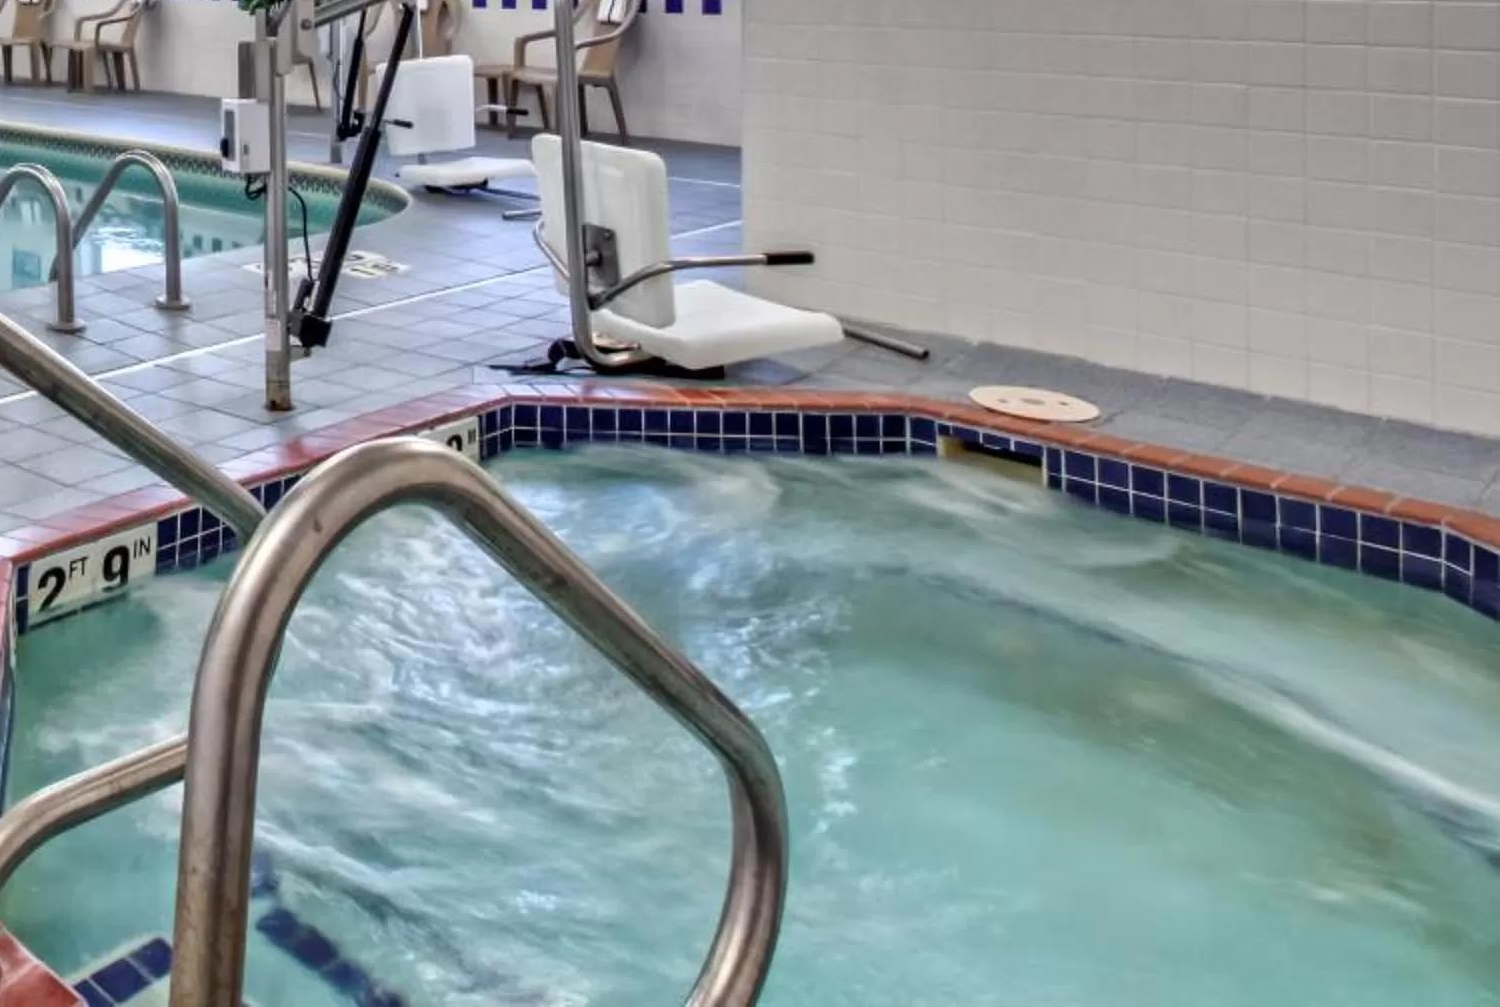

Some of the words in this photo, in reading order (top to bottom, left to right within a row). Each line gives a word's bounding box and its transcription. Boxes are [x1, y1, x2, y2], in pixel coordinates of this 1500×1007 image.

[38, 567, 66, 613] 2
[68, 556, 88, 580] FT
[102, 545, 130, 592] 9
[133, 536, 151, 558] IN
